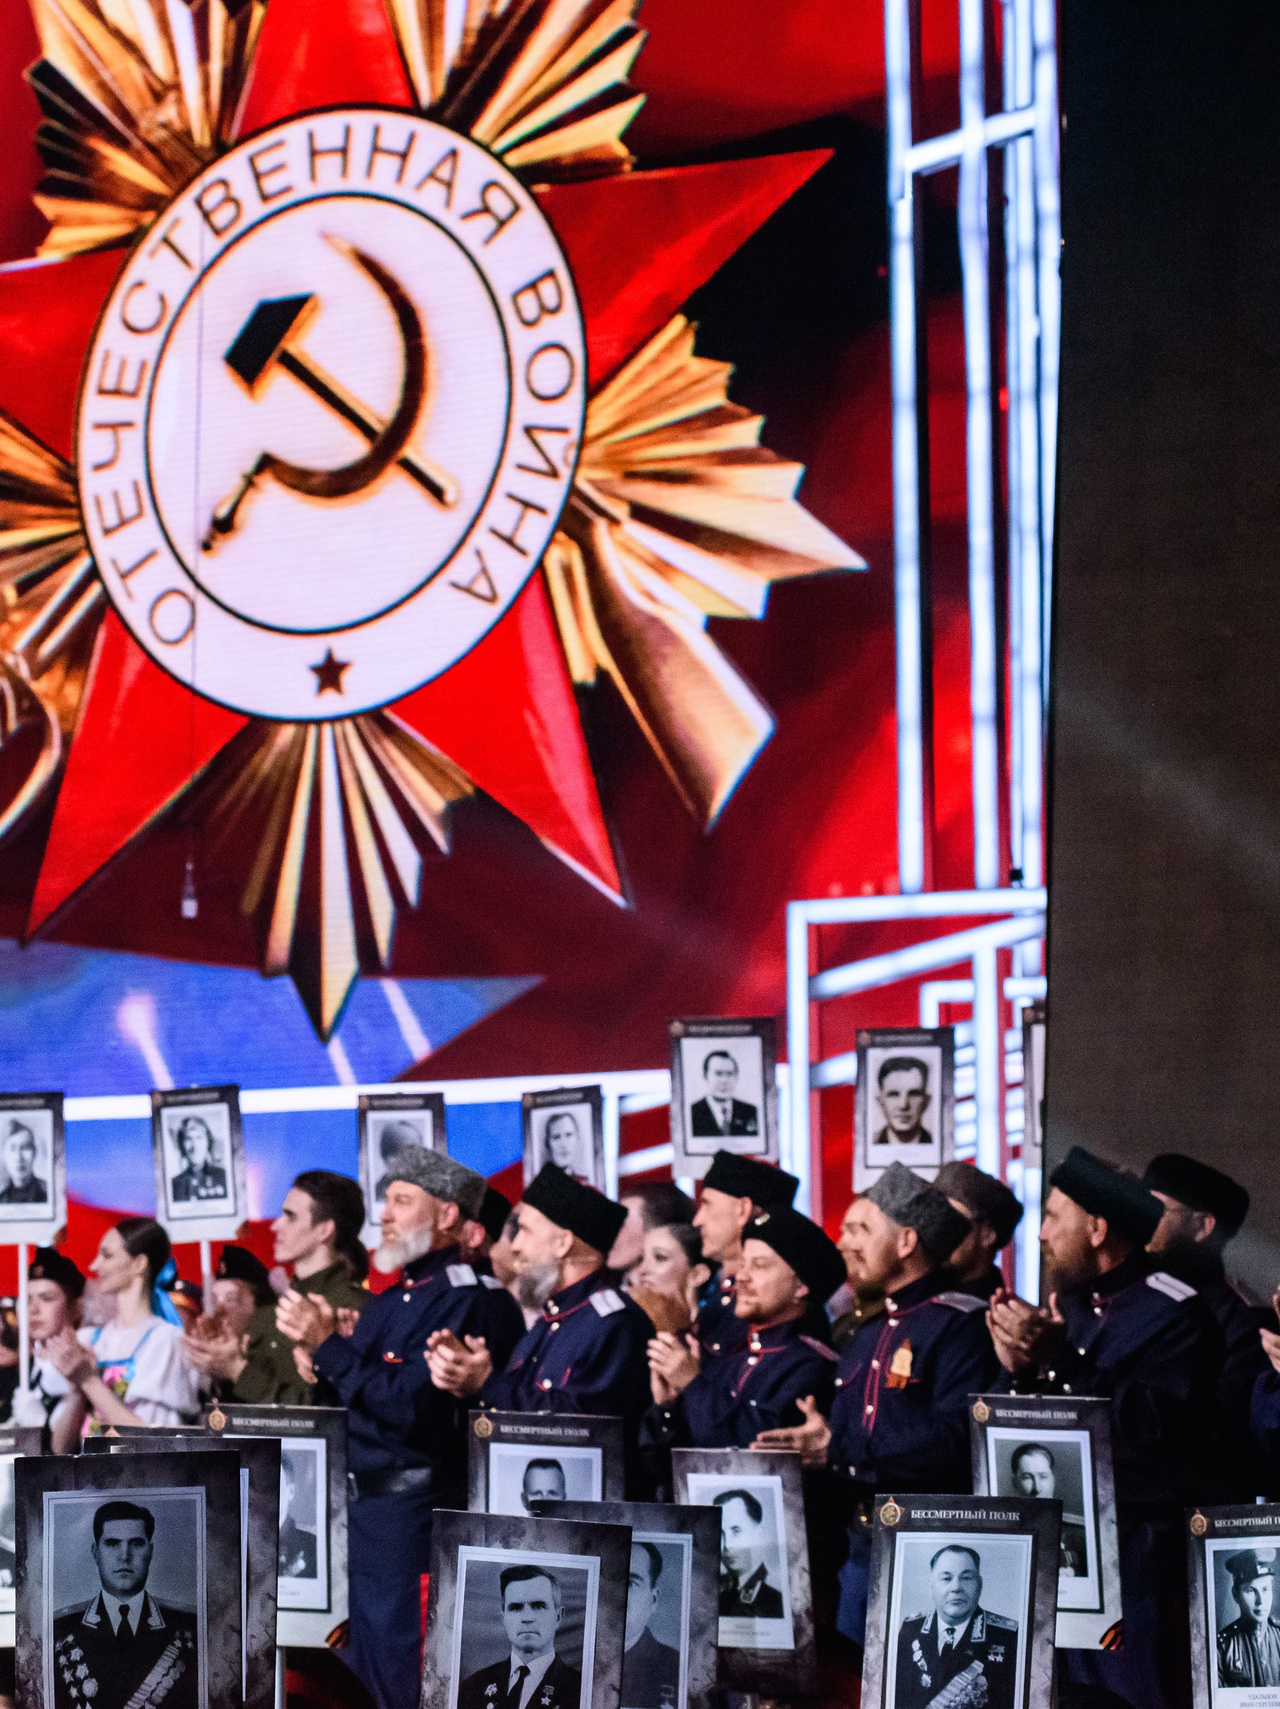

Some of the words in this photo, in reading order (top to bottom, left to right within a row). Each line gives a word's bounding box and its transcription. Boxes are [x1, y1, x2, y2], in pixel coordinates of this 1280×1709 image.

[91, 123, 522, 646] ОТЕЧЕСТВЕННАЯ
[449, 268, 576, 607] ВОЙНА
[911, 1509, 987, 1520] БЕССМЕРТНЫЙ
[989, 1511, 1021, 1521] ПОЛК
[1214, 1515, 1272, 1528] БЕССМЕРТНЫЙ
